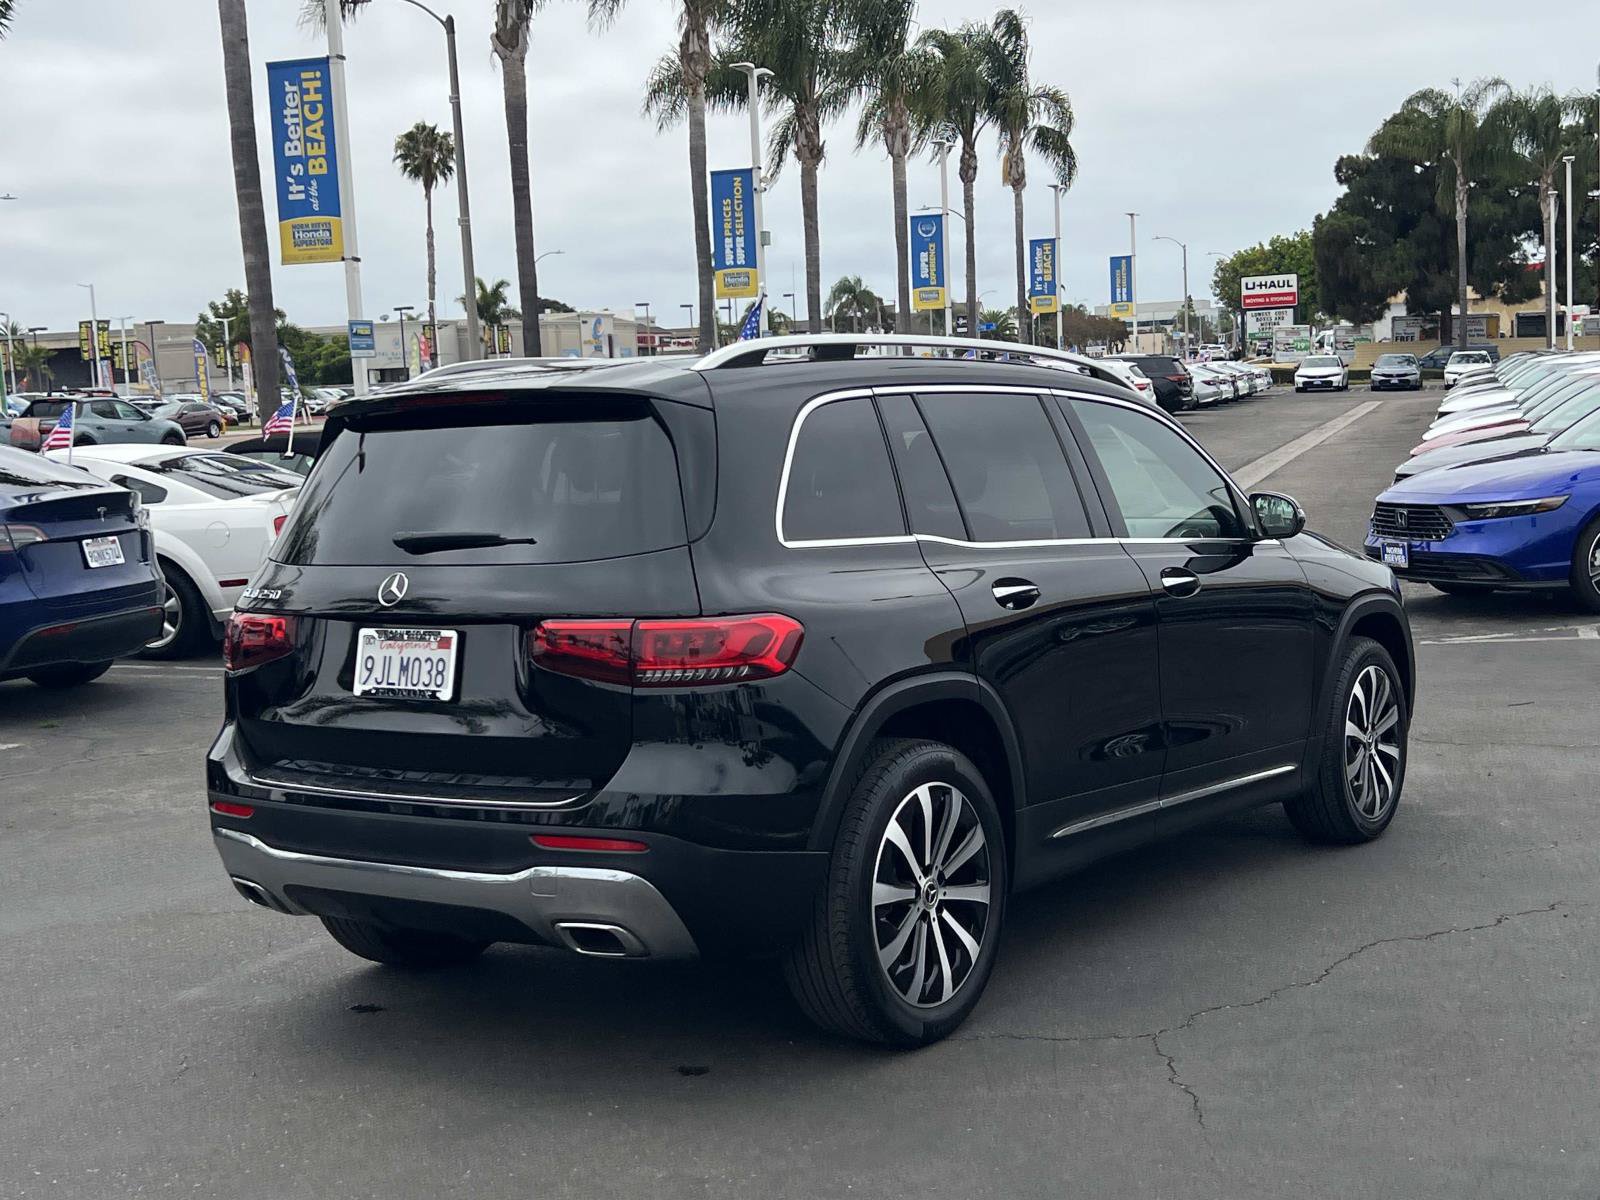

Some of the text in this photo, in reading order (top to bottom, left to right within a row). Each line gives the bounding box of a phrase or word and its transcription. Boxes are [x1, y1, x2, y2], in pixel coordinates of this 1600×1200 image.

[301, 70, 328, 175] BEACH!
[284, 80, 306, 201] It's Better
[294, 230, 330, 239] Honda
[723, 198, 734, 266] SUPER PRICES
[733, 176, 745, 265] SUPER SELECTION
[1245, 279, 1293, 291] U-HAUL
[258, 589, 282, 599] 250
[379, 640, 438, 655] California
[362, 655, 446, 688] 9JLM038
